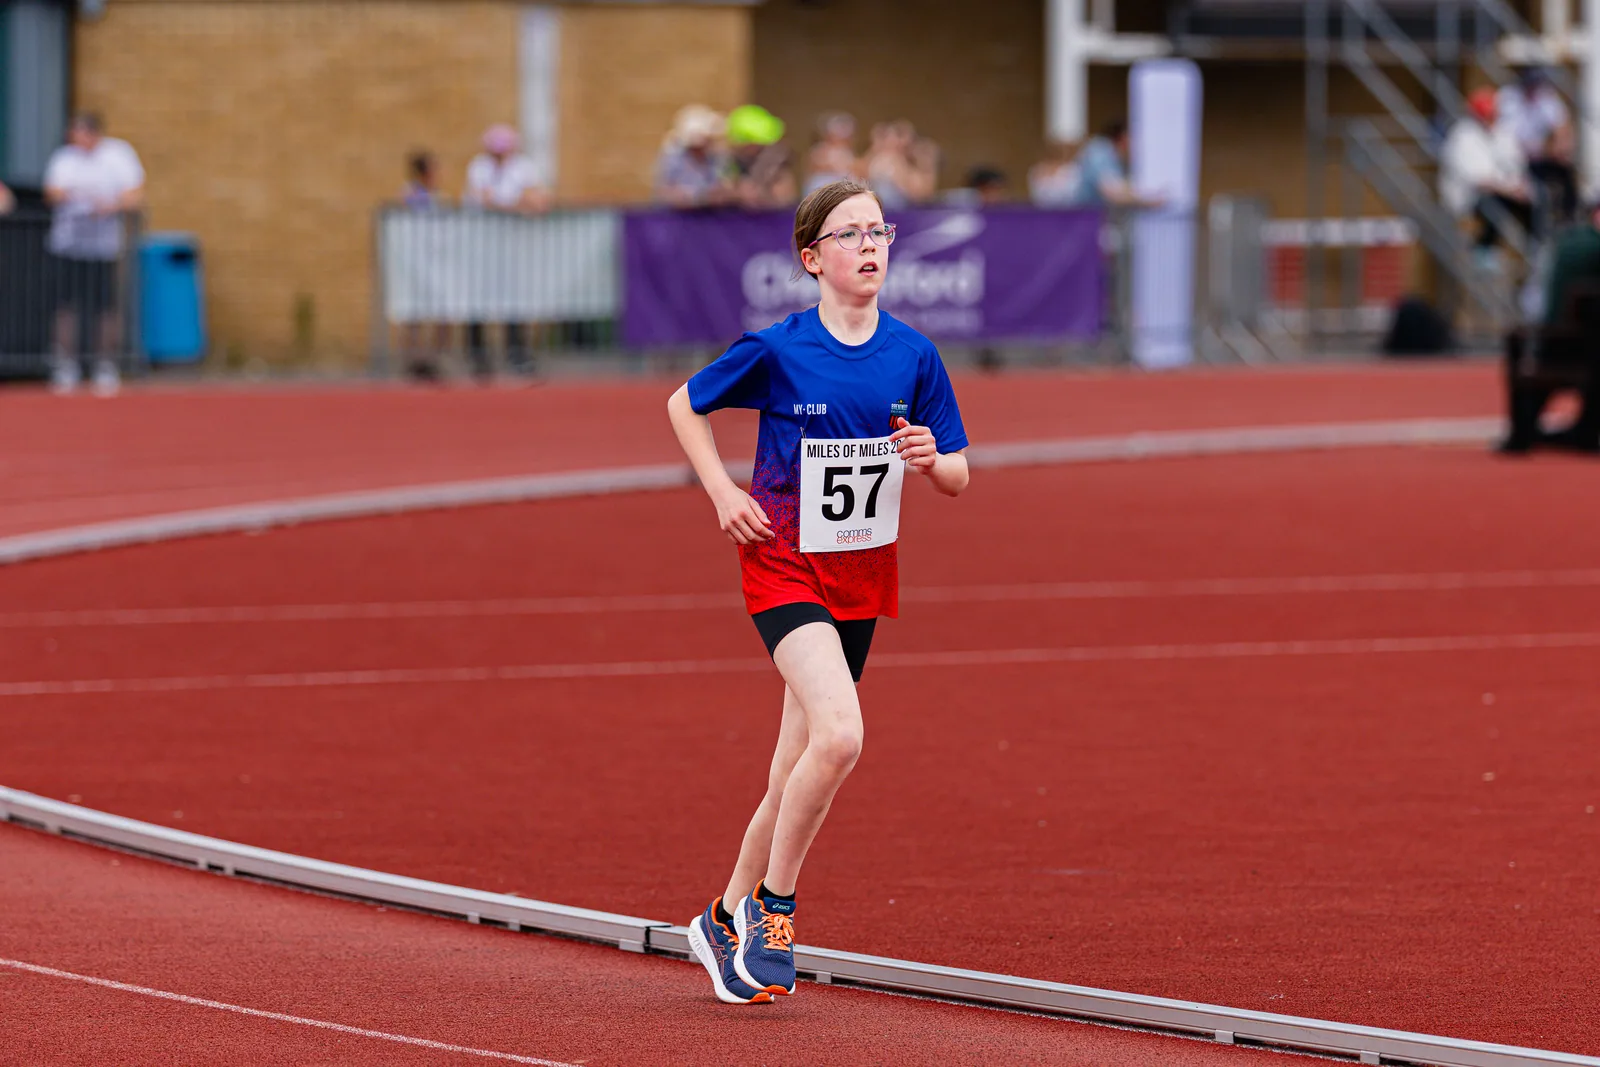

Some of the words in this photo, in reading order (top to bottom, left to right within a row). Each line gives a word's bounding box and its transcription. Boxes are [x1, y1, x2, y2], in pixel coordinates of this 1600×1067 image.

[807, 444, 840, 458] MILES
[843, 444, 857, 458] OF
[859, 442, 889, 458] MILES
[821, 463, 890, 522] 57
[836, 527, 873, 538] comms
[836, 534, 872, 544] express
